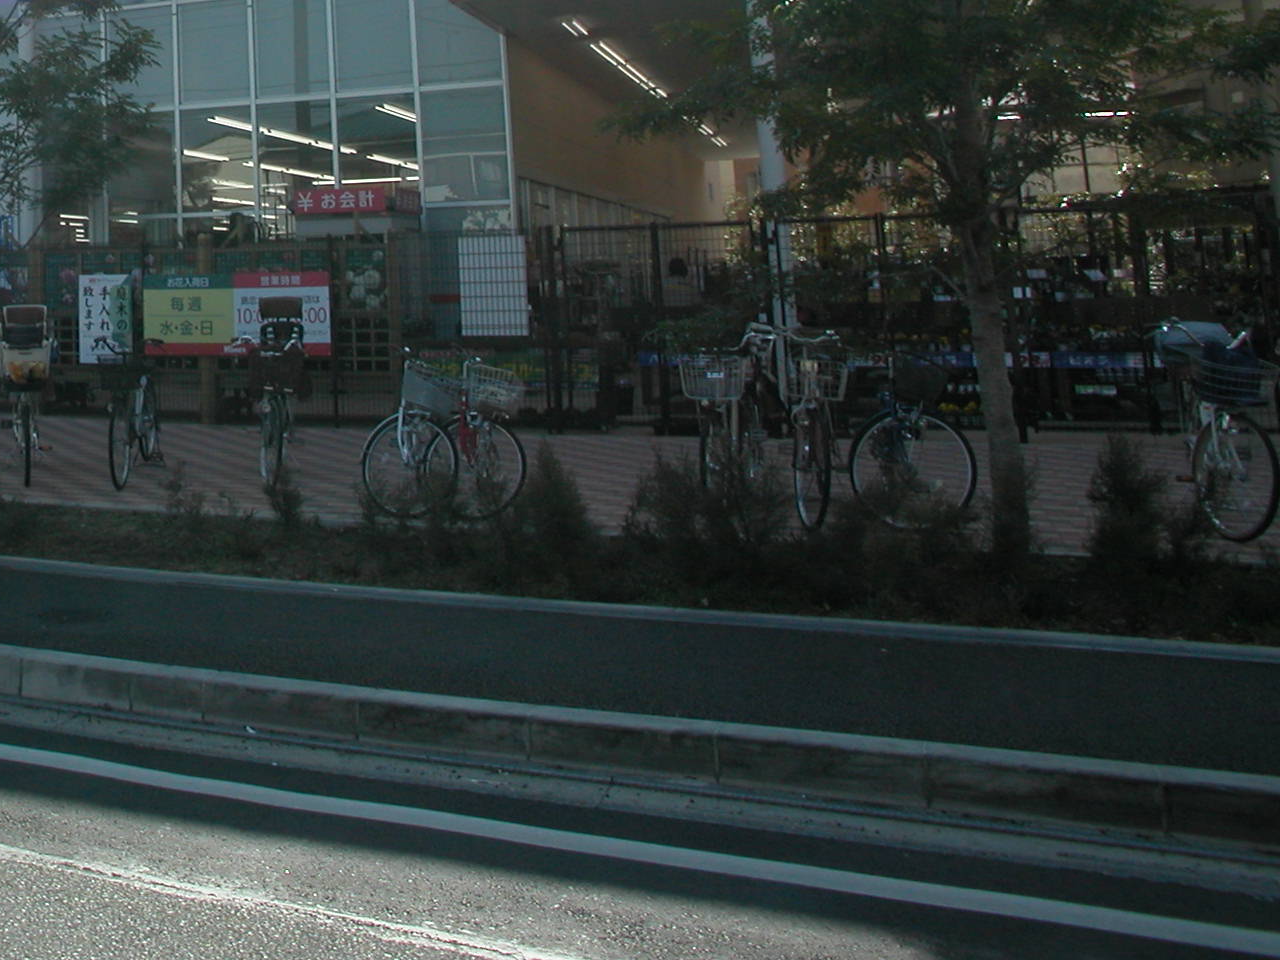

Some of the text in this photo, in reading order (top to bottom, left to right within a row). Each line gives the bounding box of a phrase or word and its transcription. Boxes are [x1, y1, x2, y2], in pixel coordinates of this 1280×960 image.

[321, 190, 375, 209] お会計
[83, 286, 95, 331] 致します
[98, 285, 111, 331] 手入れ
